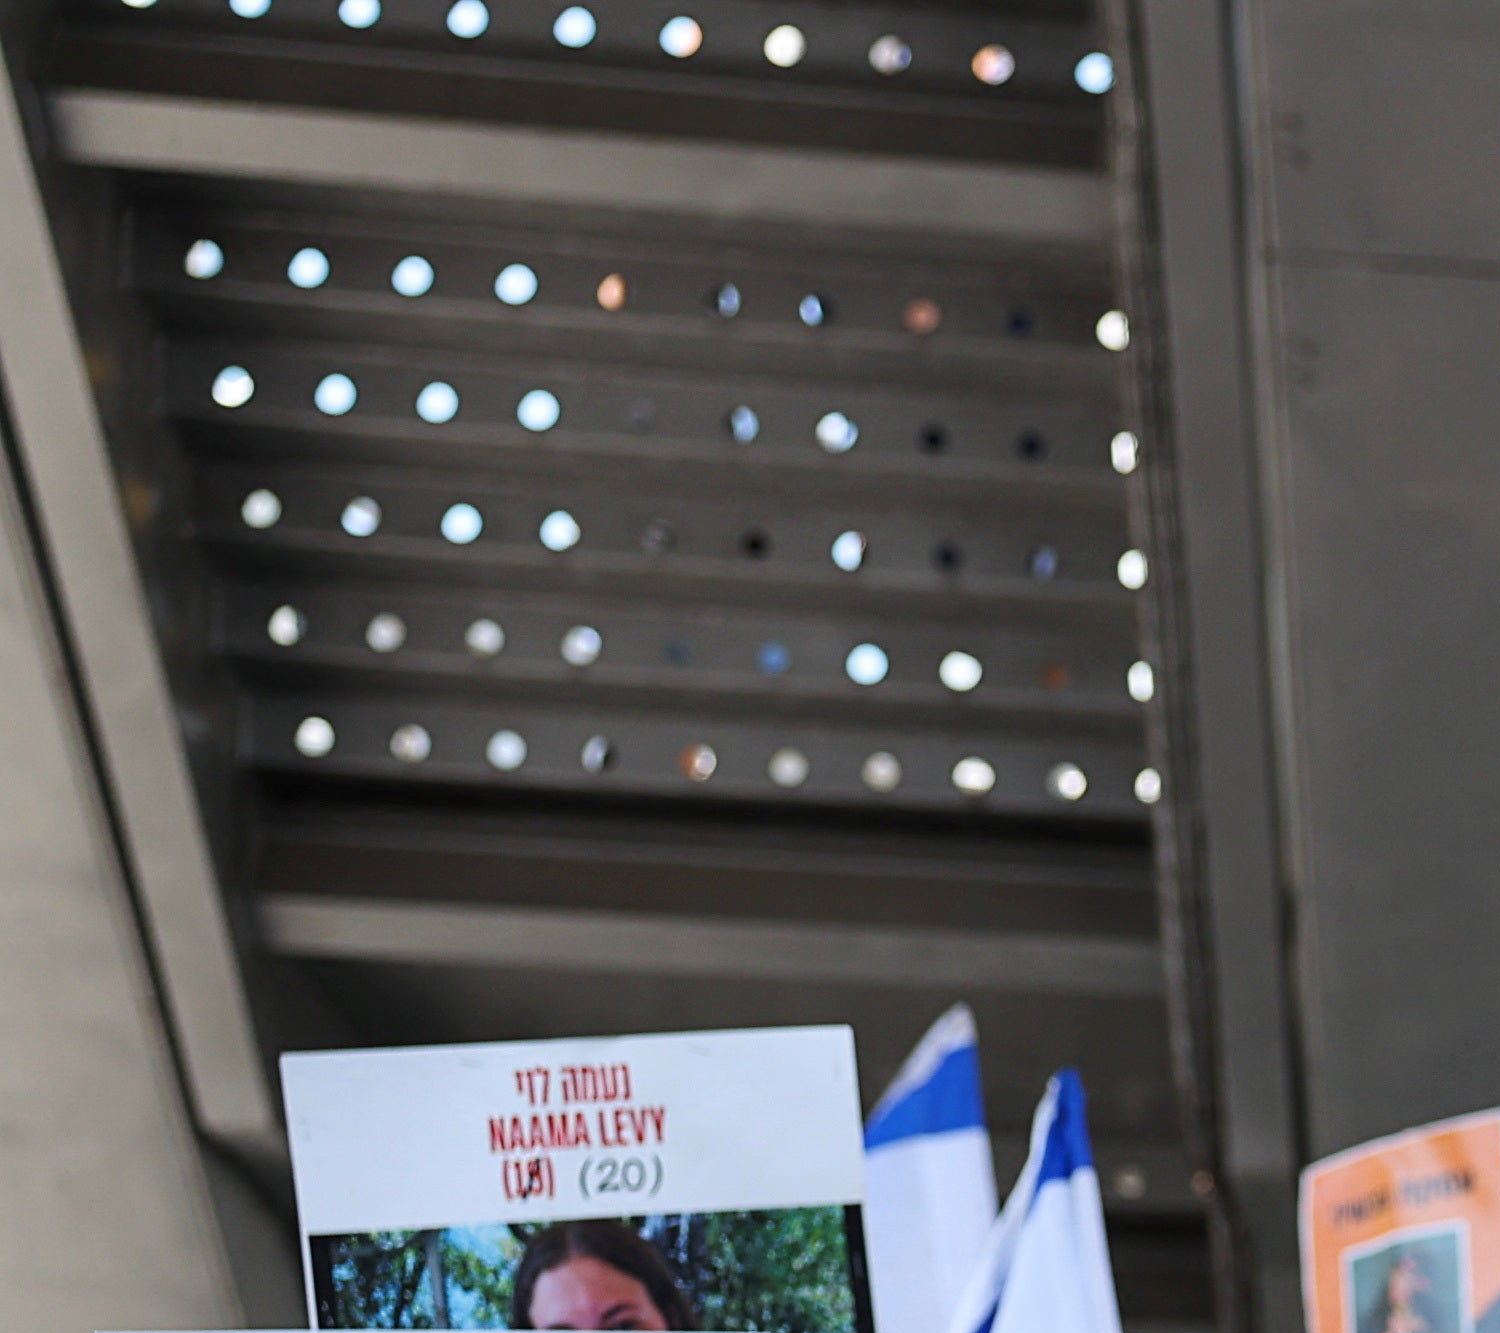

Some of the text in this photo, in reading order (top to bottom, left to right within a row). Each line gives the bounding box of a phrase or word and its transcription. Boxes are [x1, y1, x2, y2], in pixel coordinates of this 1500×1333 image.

[489, 1107, 665, 1152] NAAMA LEVY
[579, 1154, 664, 1200] (20)
